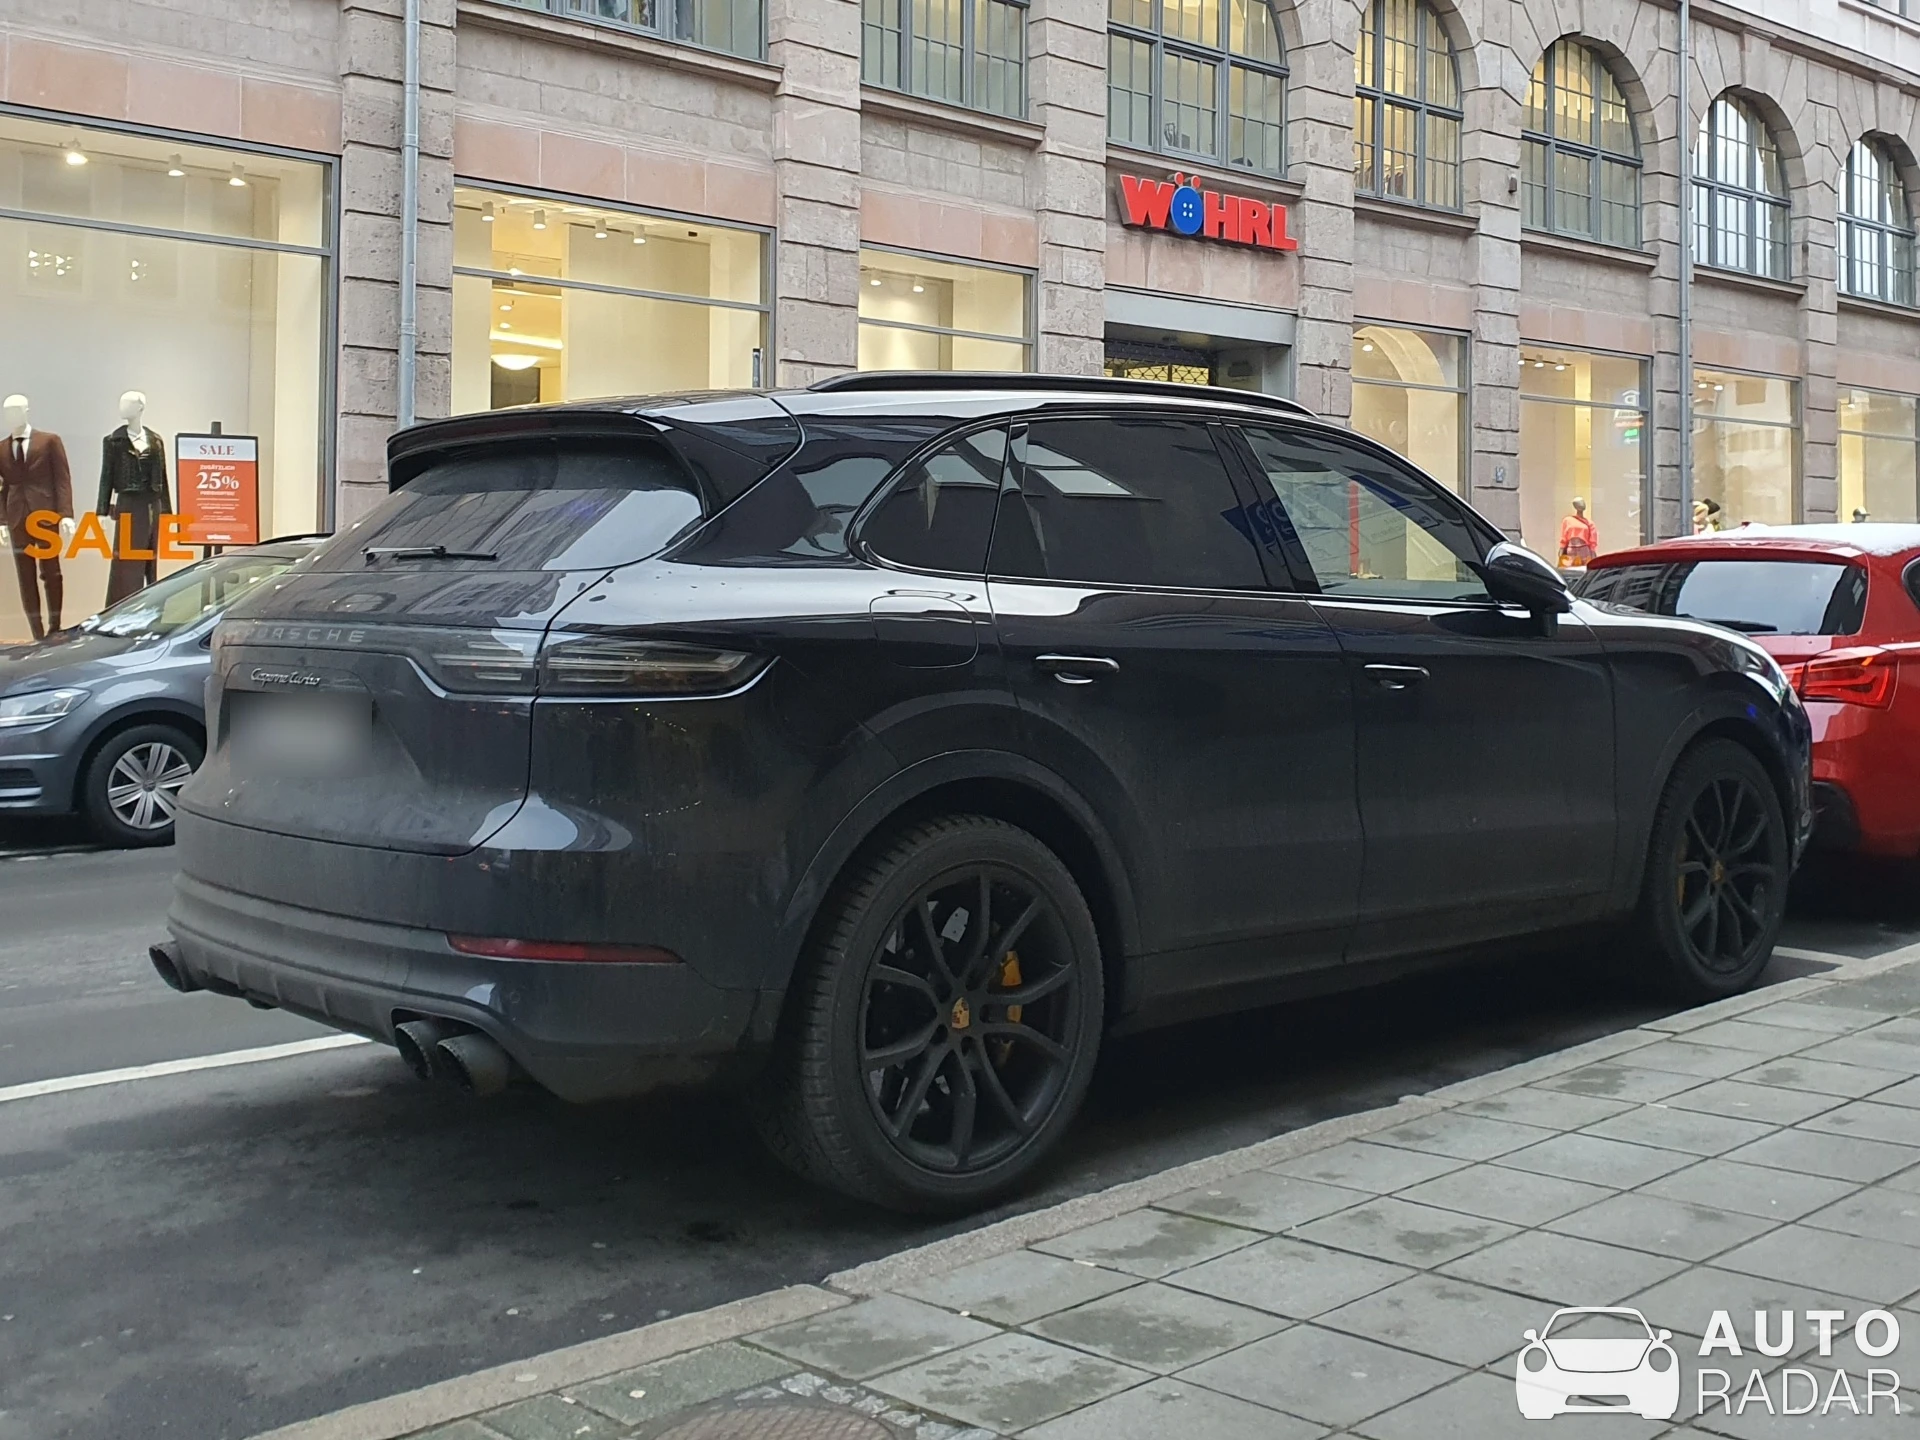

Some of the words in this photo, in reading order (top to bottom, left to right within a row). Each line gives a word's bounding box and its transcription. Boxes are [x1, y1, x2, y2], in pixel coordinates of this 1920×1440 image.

[1118, 171, 1299, 251] WÖHRL
[199, 444, 235, 456] SALE
[195, 471, 240, 490] 25%
[23, 509, 195, 560] SALE
[244, 626, 366, 643] PORSCHE
